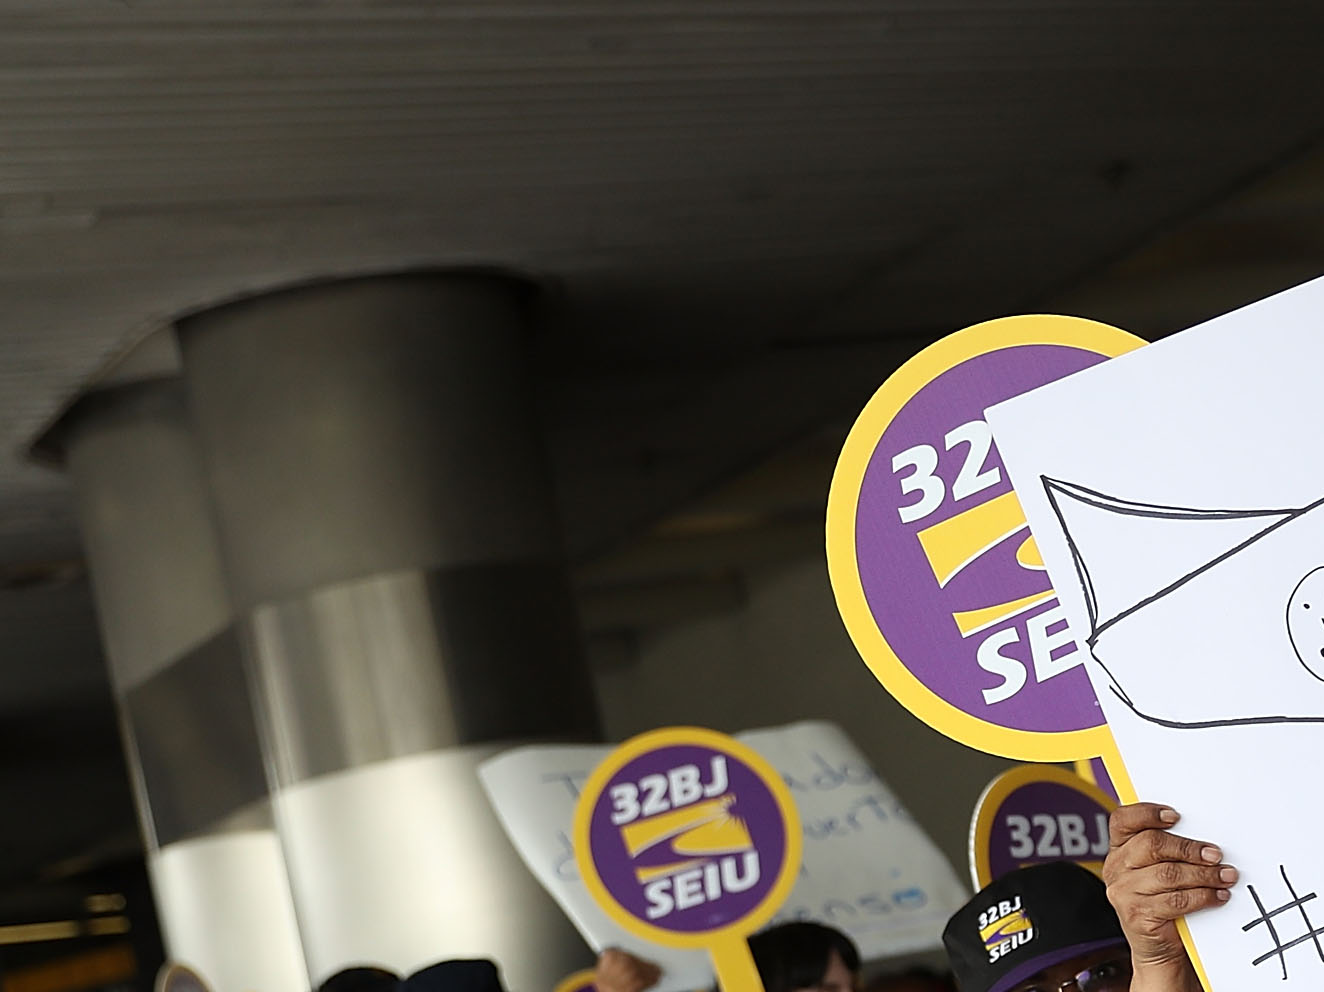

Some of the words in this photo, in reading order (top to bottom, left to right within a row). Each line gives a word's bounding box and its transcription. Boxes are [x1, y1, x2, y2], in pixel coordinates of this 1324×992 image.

[891, 420, 1001, 524] 32
[975, 604, 1085, 705] SE
[609, 755, 729, 825] 32BJ
[1006, 813, 1110, 858] 32BJ
[644, 851, 761, 920] SEIU
[978, 896, 1021, 931] 32BJ
[989, 927, 1034, 964] SEIU
